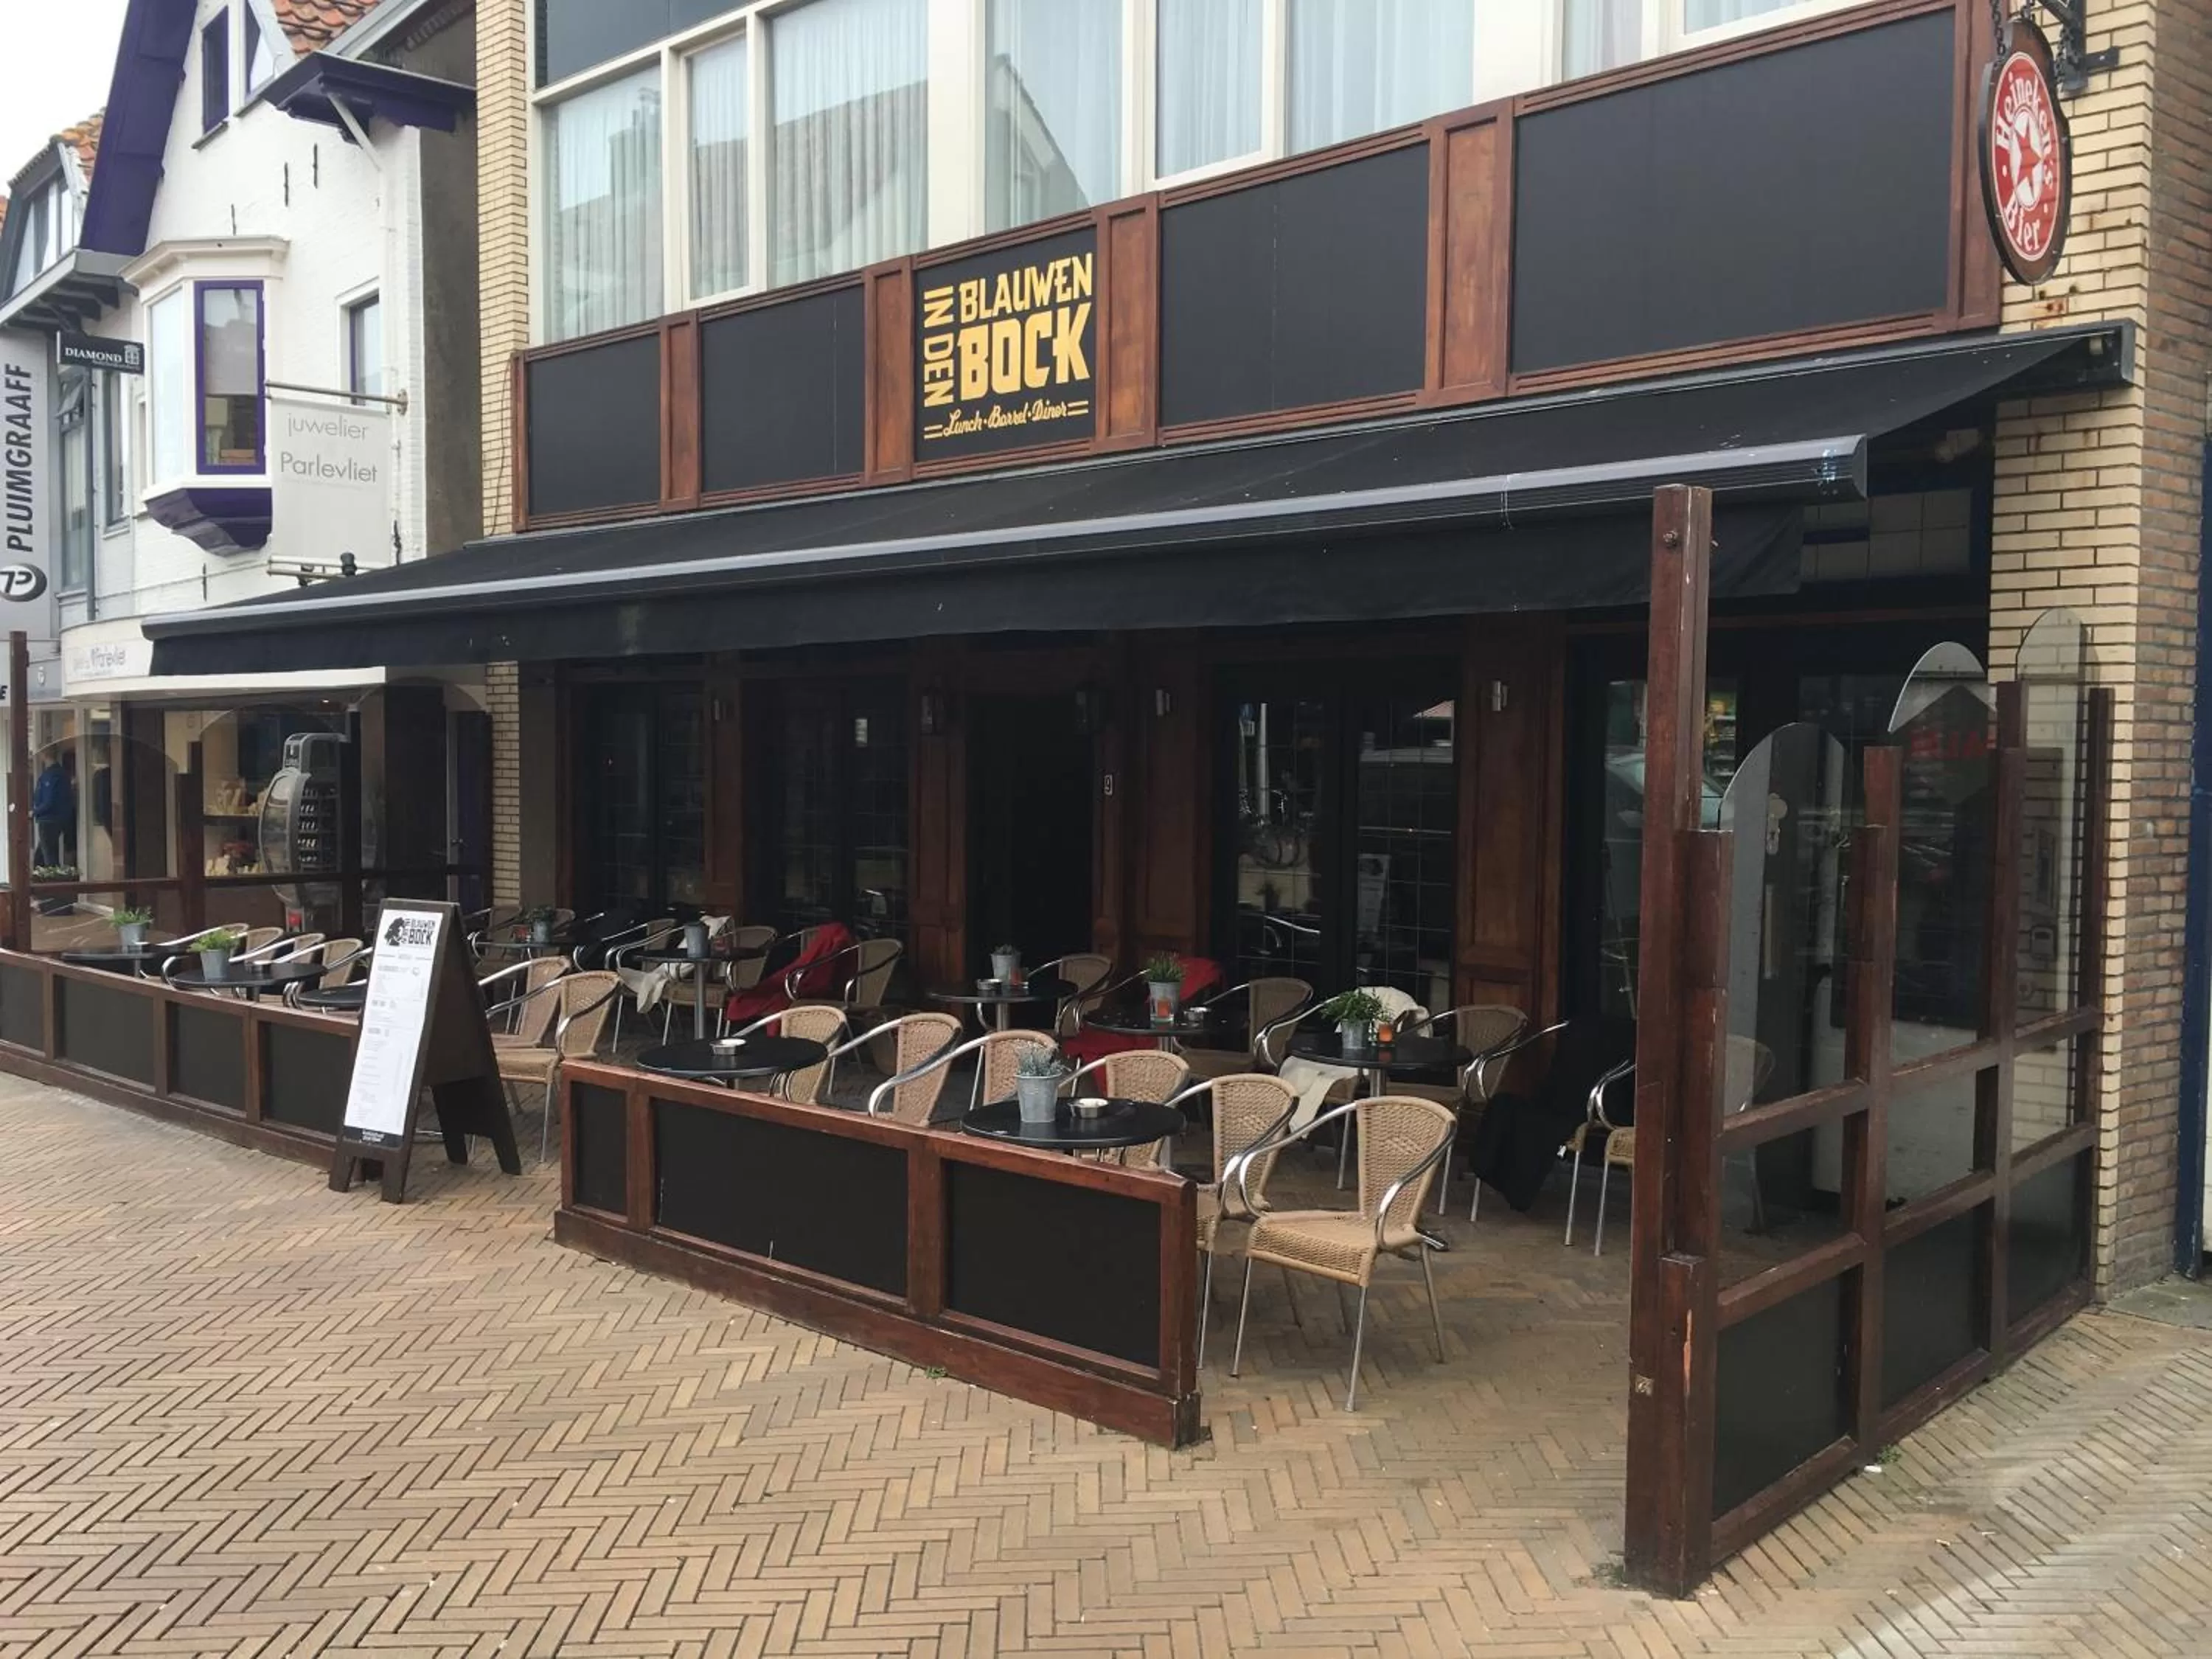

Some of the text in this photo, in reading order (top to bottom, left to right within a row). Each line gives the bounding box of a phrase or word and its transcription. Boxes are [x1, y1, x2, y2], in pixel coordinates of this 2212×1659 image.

[2004, 192, 2040, 251] Bier
[959, 252, 1093, 324] BLAUWEN
[64, 347, 122, 363] DIAMOND
[924, 285, 954, 408] IN DEN
[957, 302, 1092, 401] BOCK
[287, 412, 369, 440] juwelier
[942, 408, 982, 437] Lunch
[4, 364, 34, 553] PLUIMGRAAFF
[280, 451, 378, 484] Parlevliet
[408, 928, 434, 946] BOCK
